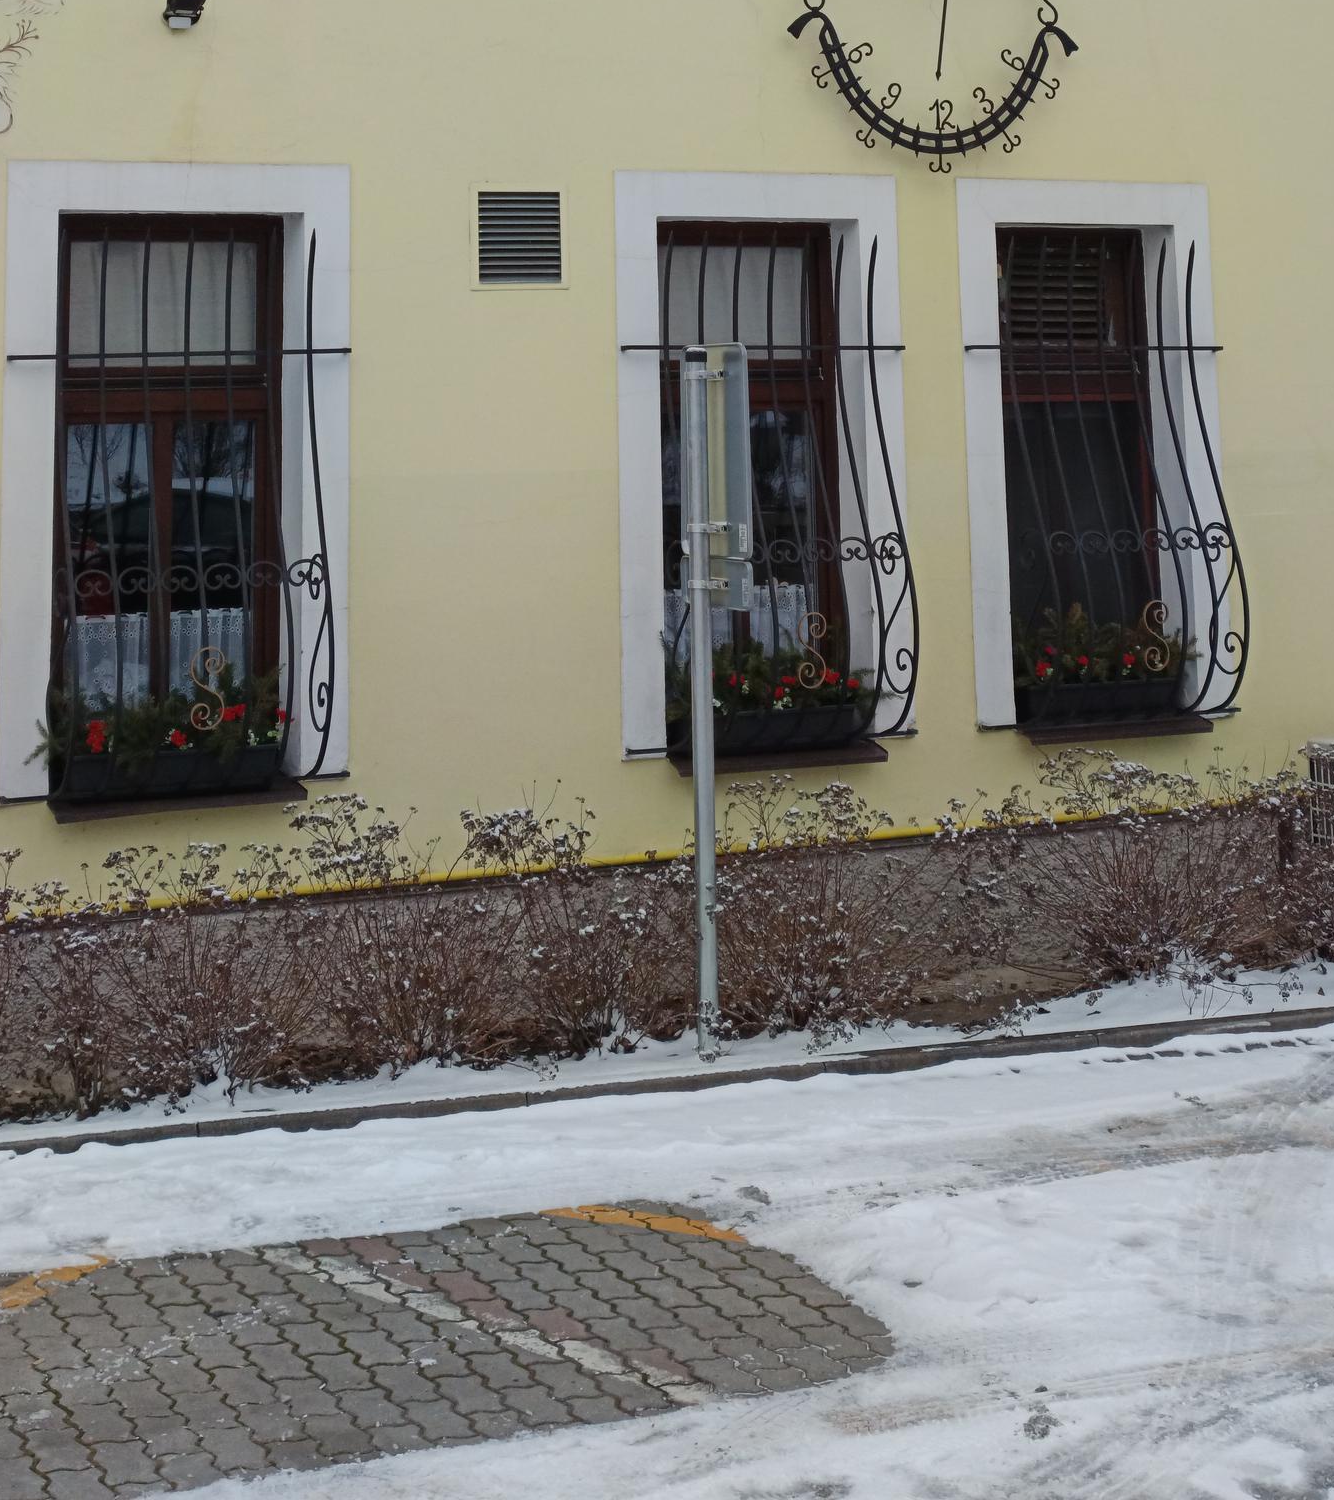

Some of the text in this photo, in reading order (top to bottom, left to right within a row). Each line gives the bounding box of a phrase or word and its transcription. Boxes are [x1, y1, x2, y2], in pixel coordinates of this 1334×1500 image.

[1000, 49, 1026, 71] 6
[880, 82, 902, 110] 9
[972, 86, 995, 115] 3
[928, 98, 956, 131] 12
